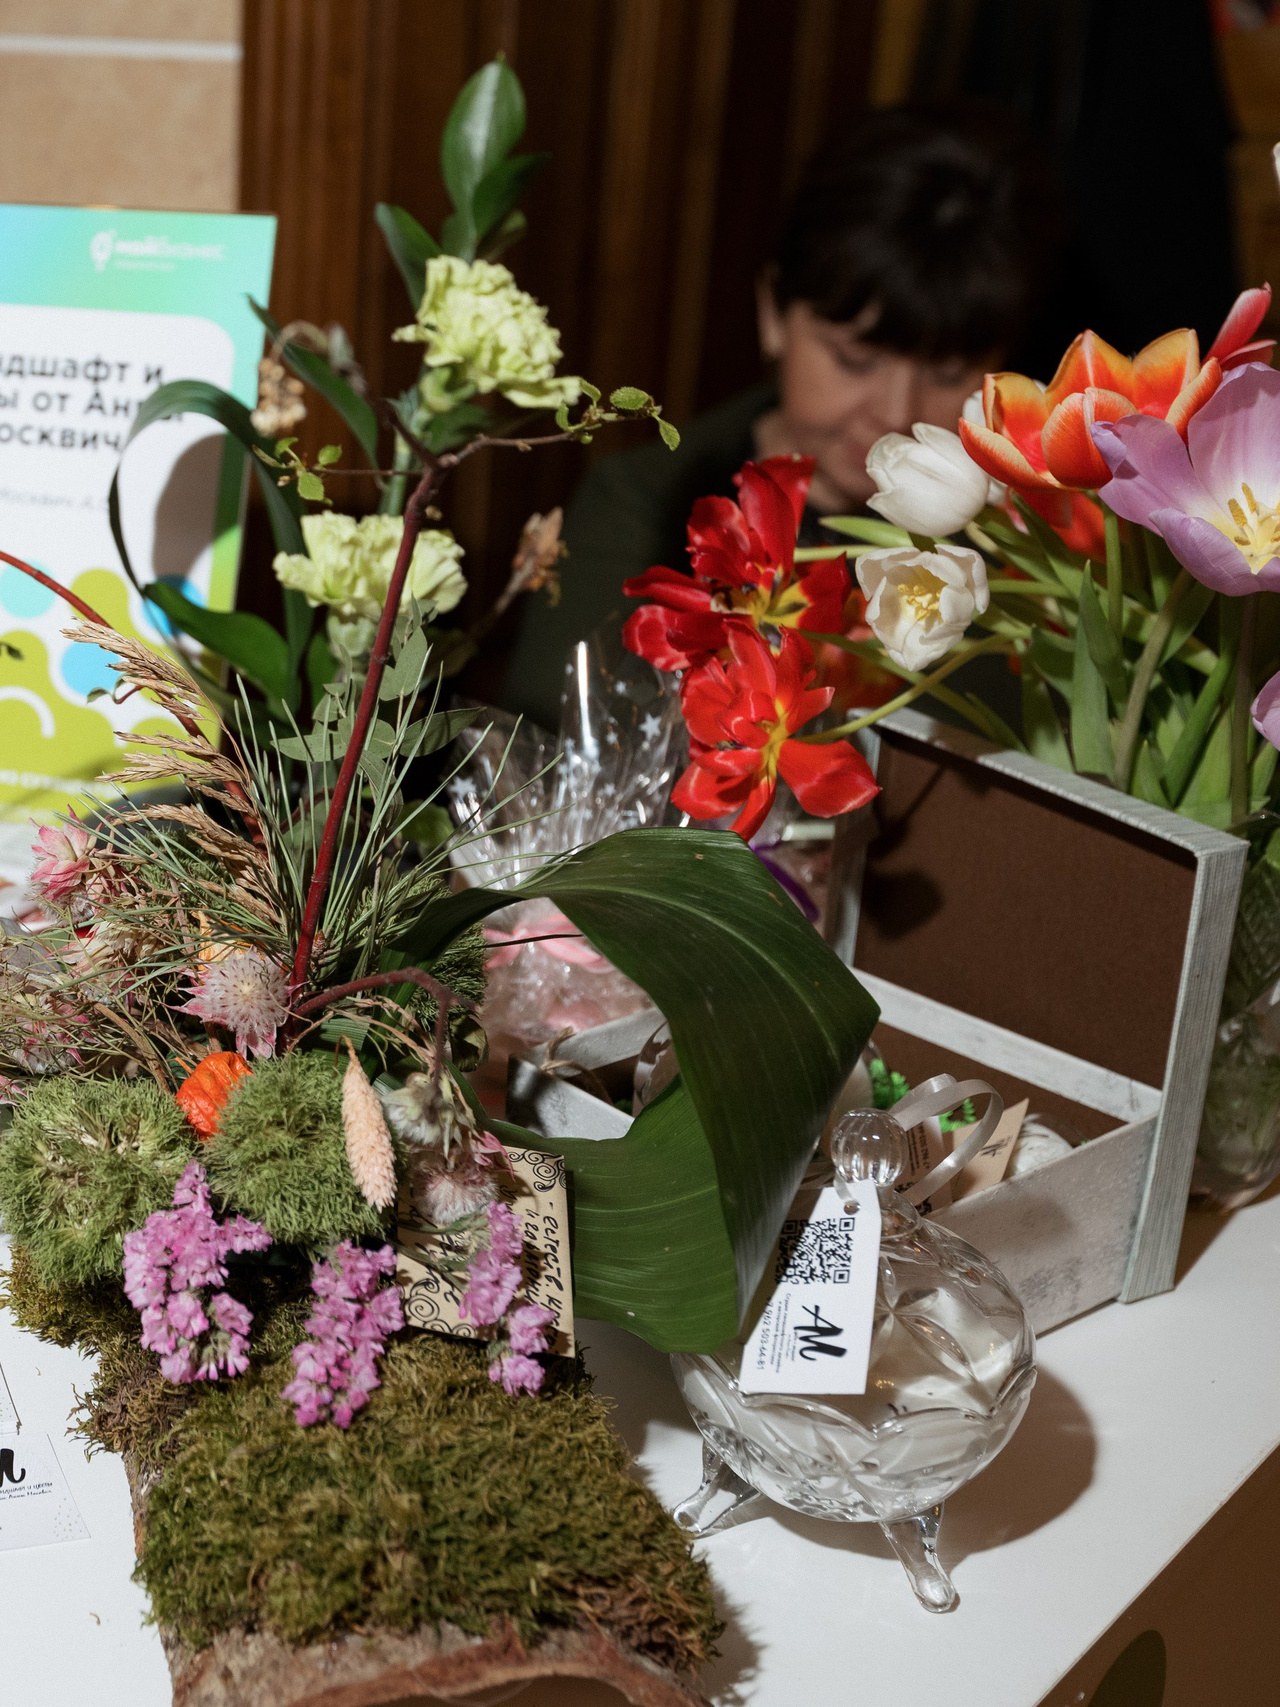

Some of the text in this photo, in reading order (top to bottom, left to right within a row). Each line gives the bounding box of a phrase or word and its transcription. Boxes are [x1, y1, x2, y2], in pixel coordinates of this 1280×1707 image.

[144, 364, 164, 383] и
[33, 391, 69, 411] от
[763, 1309, 773, 1326] 962
